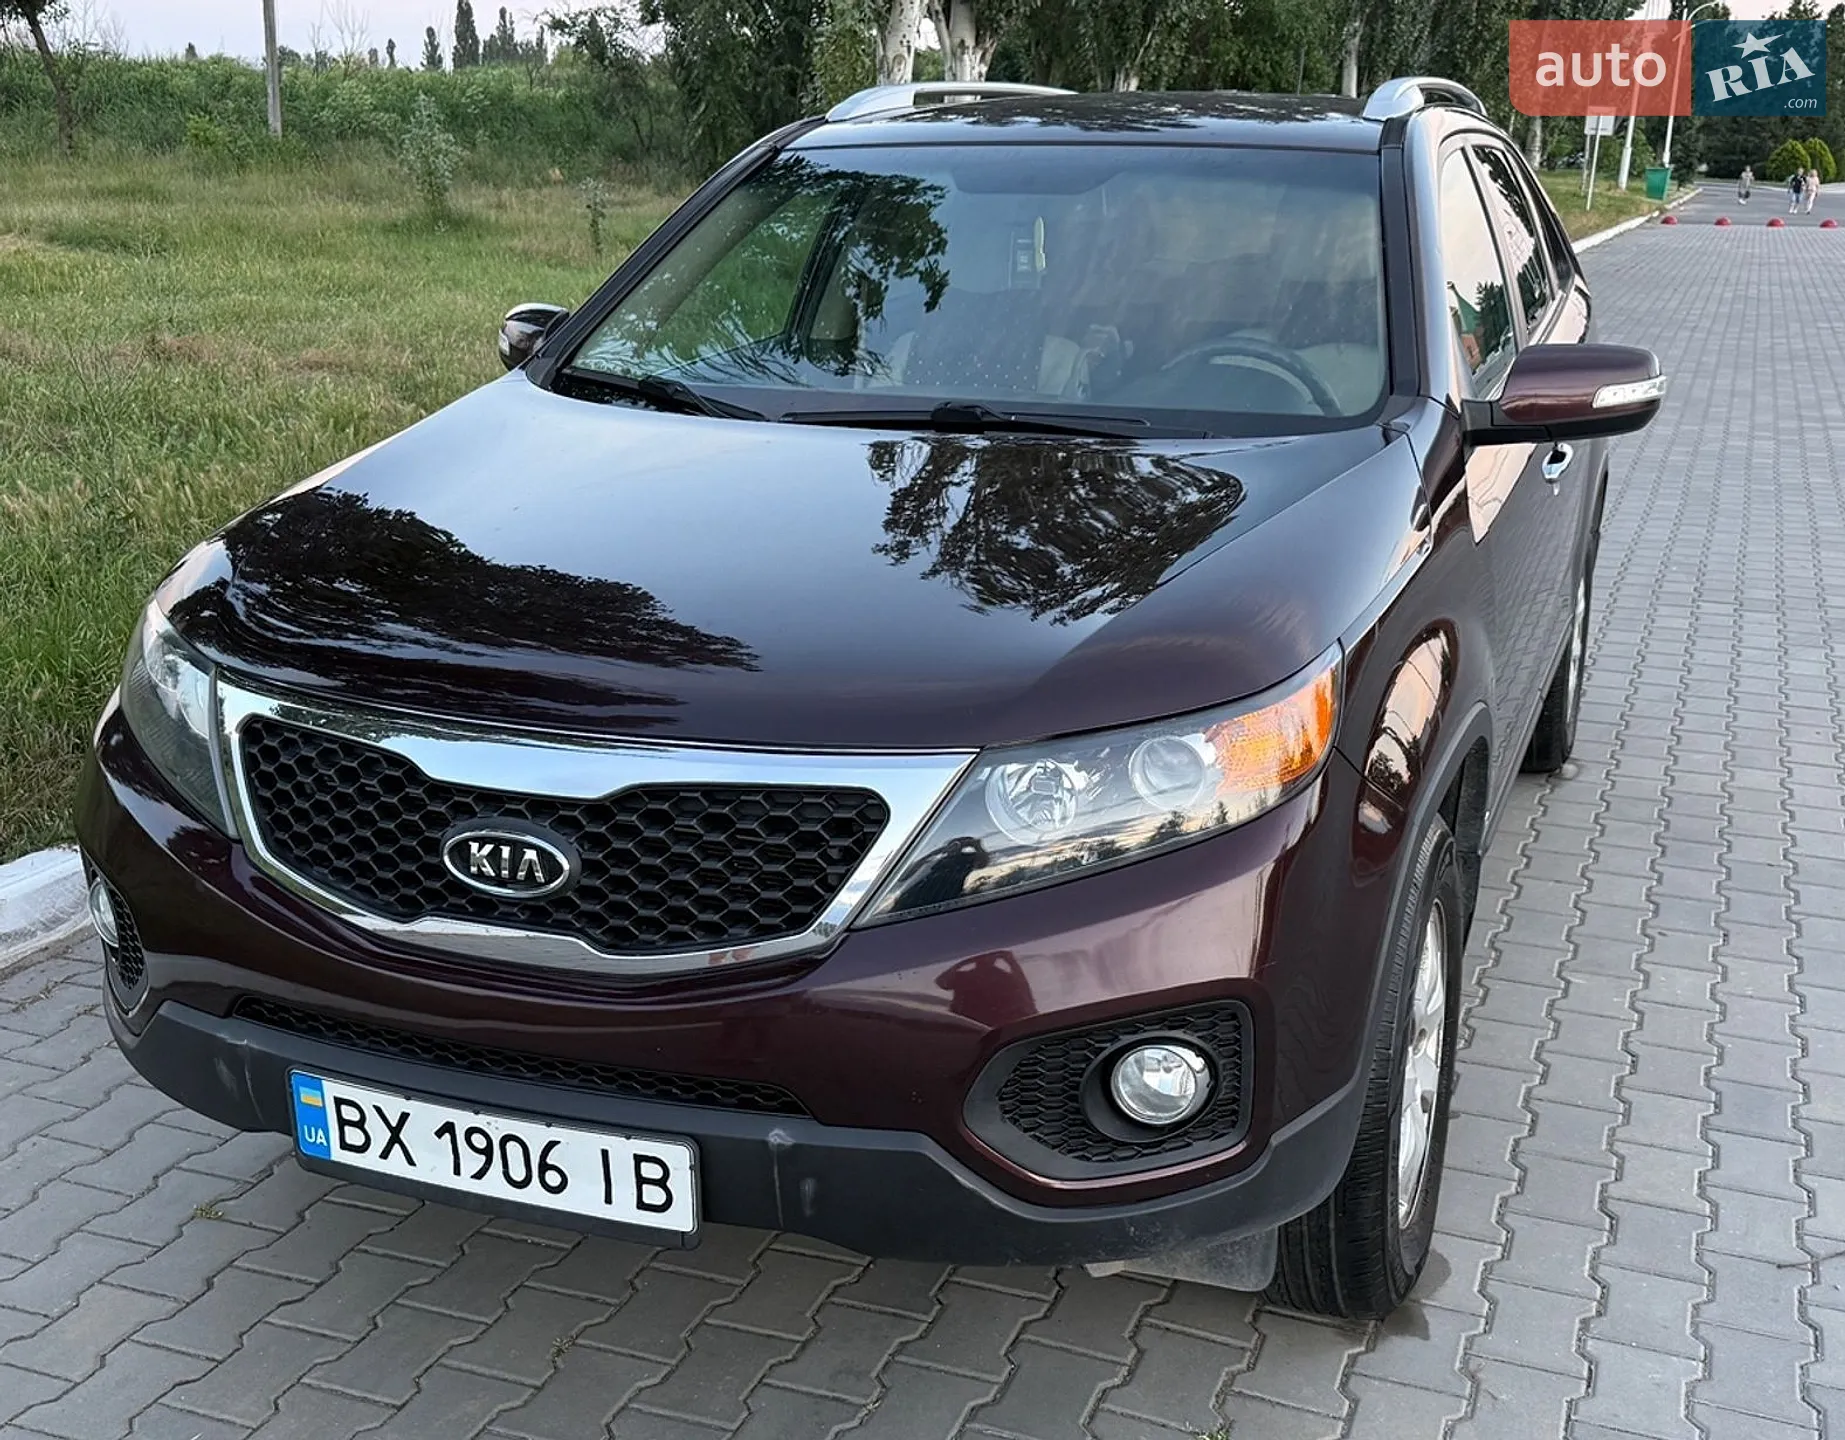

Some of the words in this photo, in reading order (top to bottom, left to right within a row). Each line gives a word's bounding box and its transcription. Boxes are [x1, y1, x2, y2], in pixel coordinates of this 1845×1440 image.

[468, 841, 545, 883] KIA
[304, 1124, 328, 1147] UA
[333, 1095, 417, 1167] BX
[434, 1120, 569, 1195] 1906
[601, 1148, 674, 1213] IB
